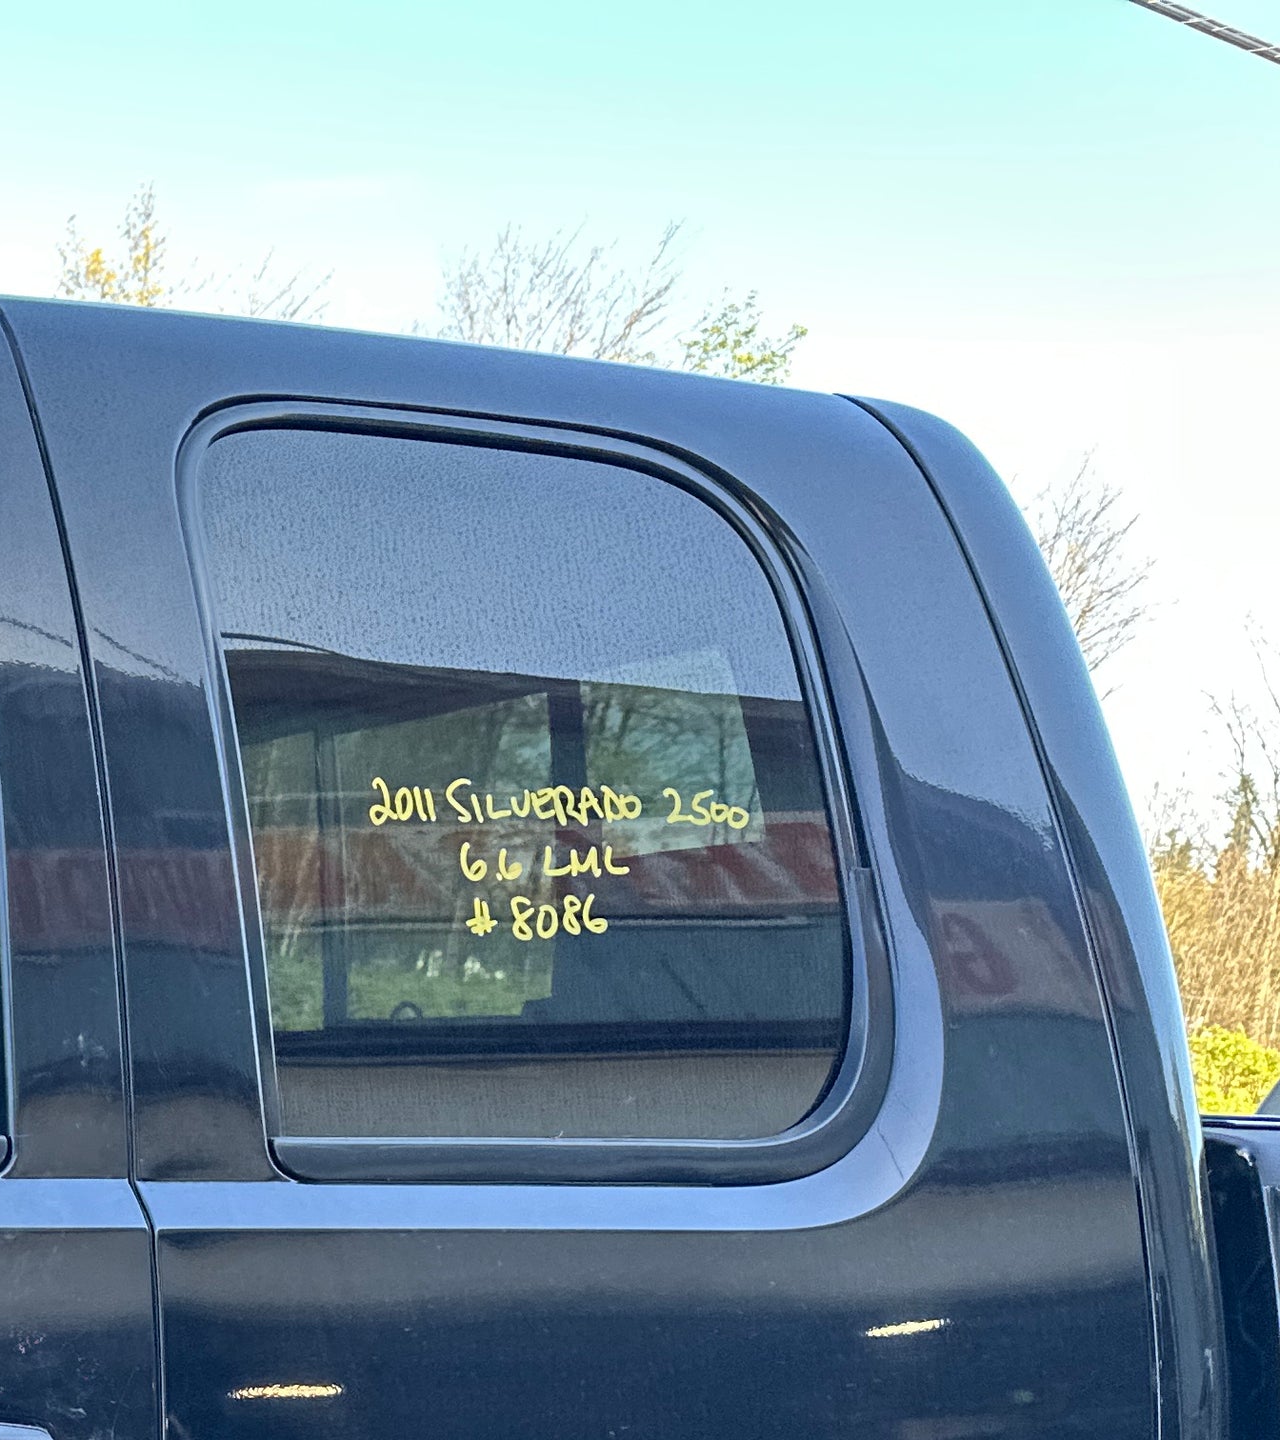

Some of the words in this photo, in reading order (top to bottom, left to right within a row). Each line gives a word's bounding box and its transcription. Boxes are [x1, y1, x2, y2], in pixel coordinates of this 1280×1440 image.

[368, 776, 437, 826] 2011
[445, 777, 642, 827] SILVERADO
[662, 787, 750, 830] 2500
[459, 842, 523, 882] 6.6
[543, 845, 630, 878] LML
[465, 897, 498, 937] #
[510, 893, 609, 941] 8086
